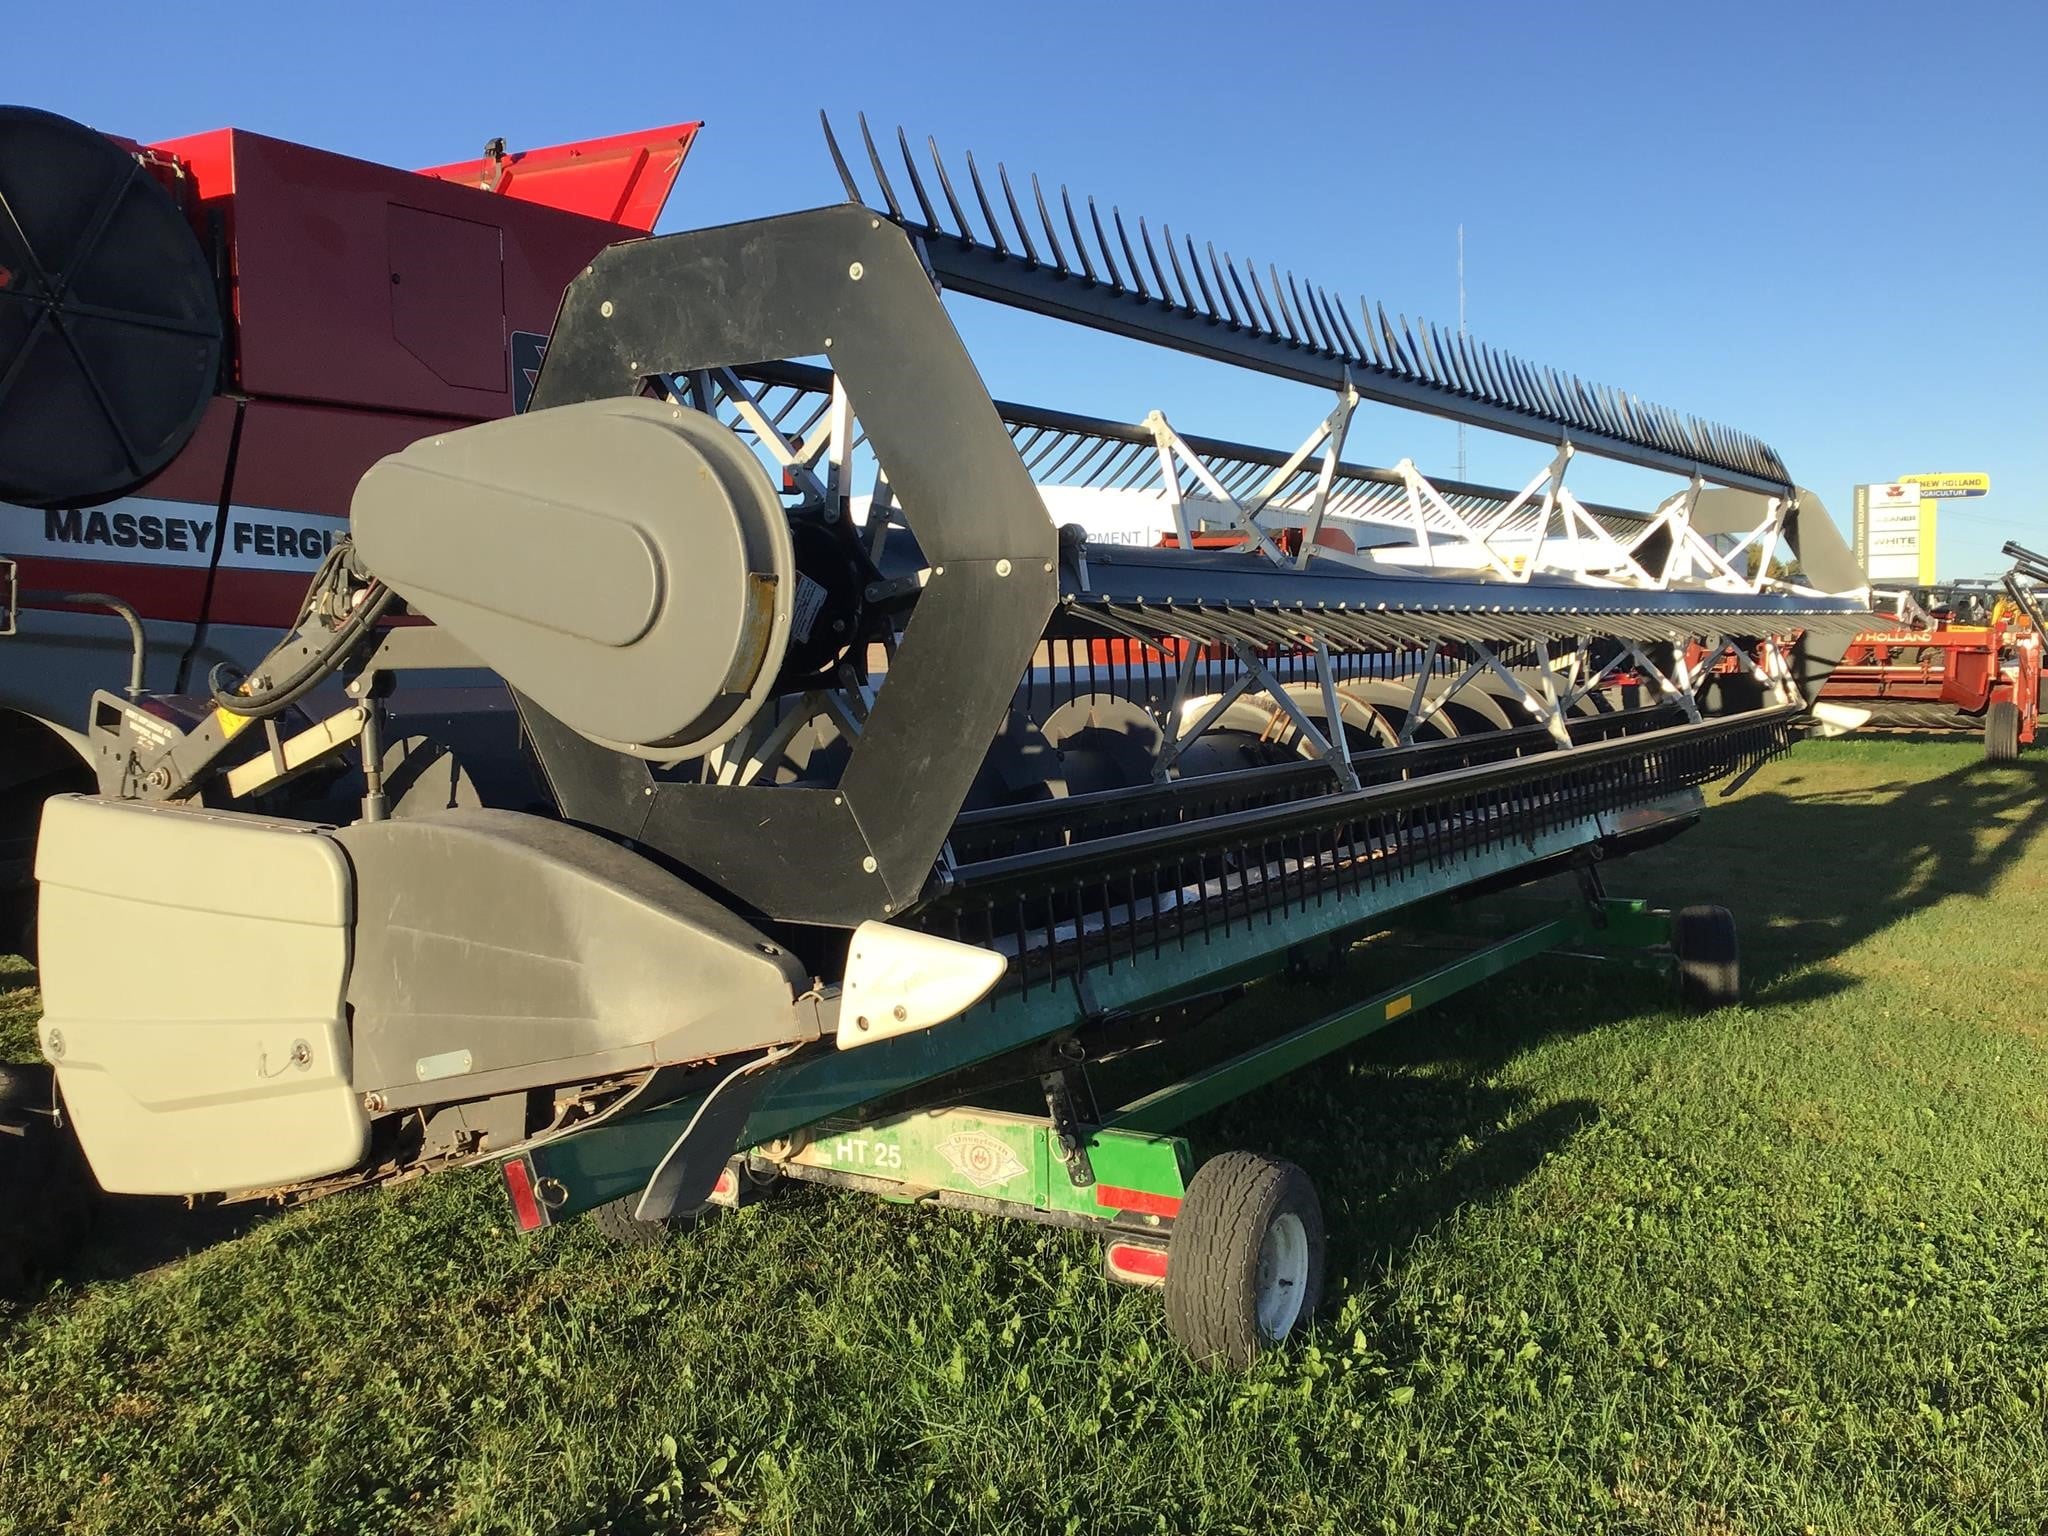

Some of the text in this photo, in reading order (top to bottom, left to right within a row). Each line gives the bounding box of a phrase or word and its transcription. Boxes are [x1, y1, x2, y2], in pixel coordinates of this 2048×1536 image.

[1942, 478, 1982, 487] HOLLAND
[44, 508, 213, 552] MASSEY
[1874, 536, 1916, 545] WHITE
[1865, 632, 1932, 642] HOLLAND
[837, 1138, 902, 1168] HT 25
